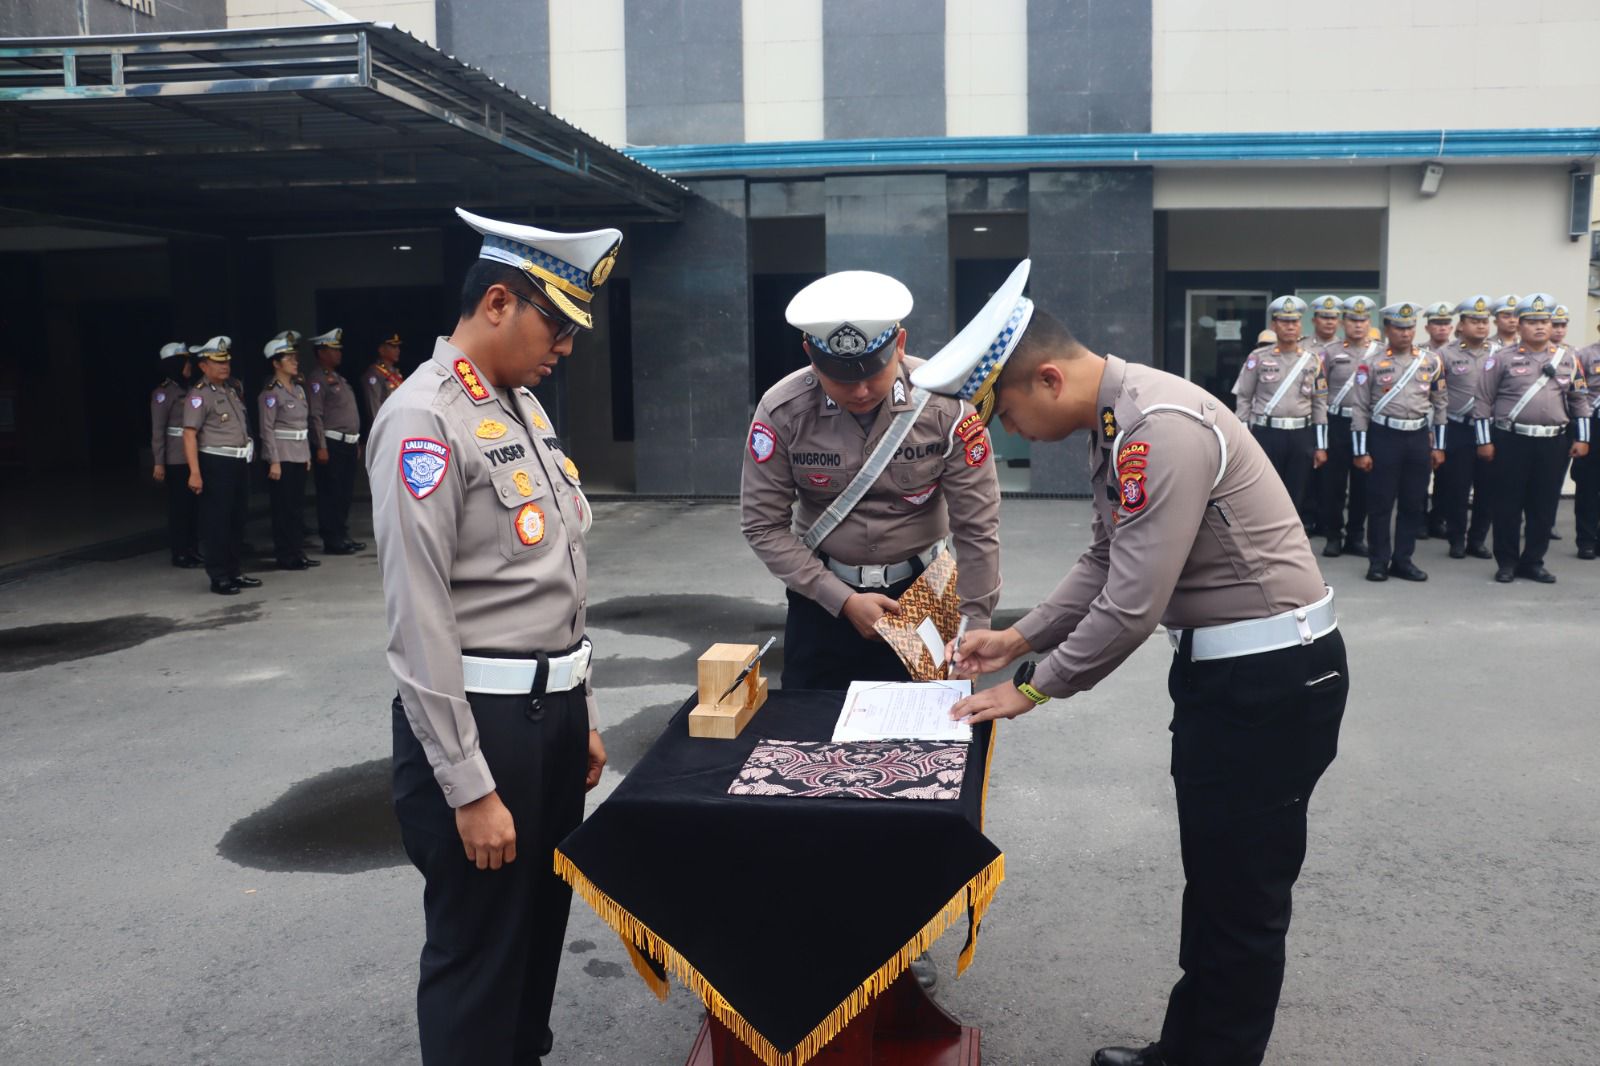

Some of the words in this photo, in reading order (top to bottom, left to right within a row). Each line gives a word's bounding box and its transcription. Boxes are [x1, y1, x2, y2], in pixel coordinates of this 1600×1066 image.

[958, 413, 981, 434] POLDA
[405, 440, 424, 450] LALU
[423, 441, 447, 455] LINTAS
[484, 443, 526, 467] YUSEP
[1119, 444, 1145, 463] POLDA
[792, 452, 841, 467] NUGROHO
